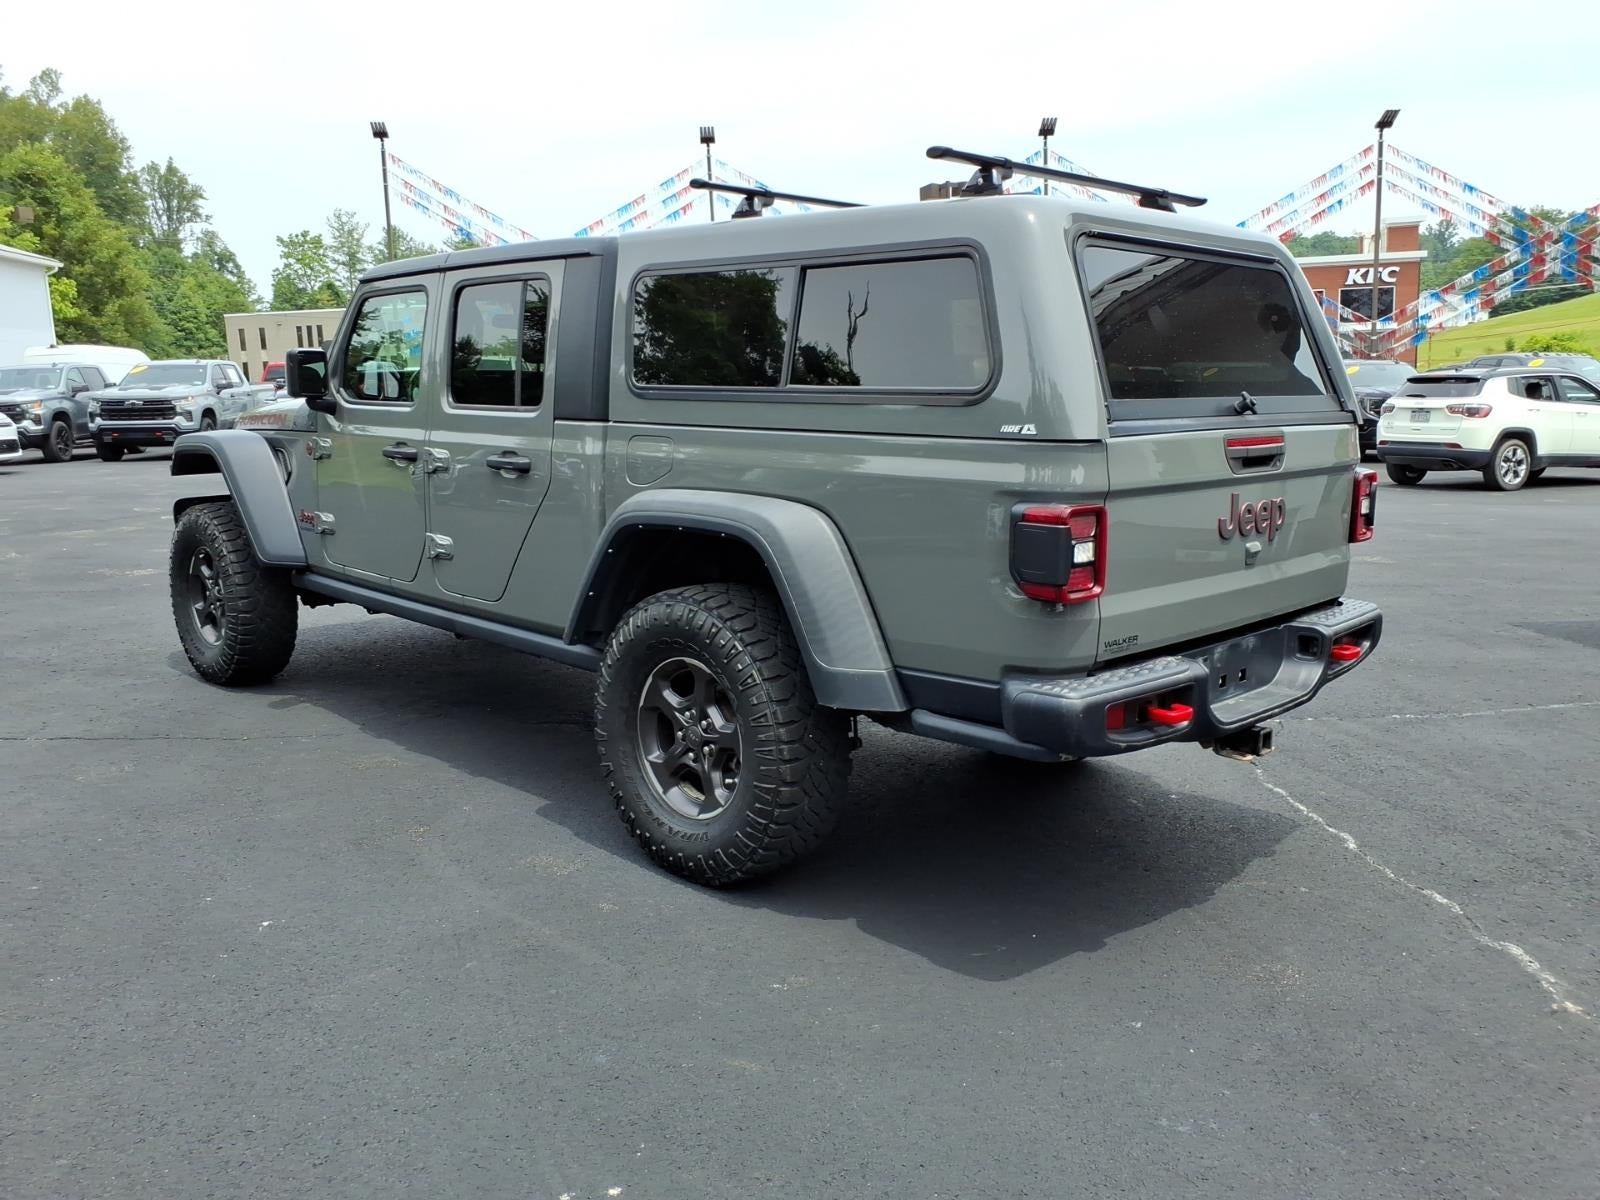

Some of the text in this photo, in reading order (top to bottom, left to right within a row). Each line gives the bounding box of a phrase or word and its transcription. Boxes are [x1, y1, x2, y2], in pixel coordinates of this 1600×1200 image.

[1345, 266, 1400, 285] KFC
[238, 413, 288, 426] RUBICON
[1218, 492, 1286, 543] Jeep
[1104, 635, 1139, 648] WALKER
